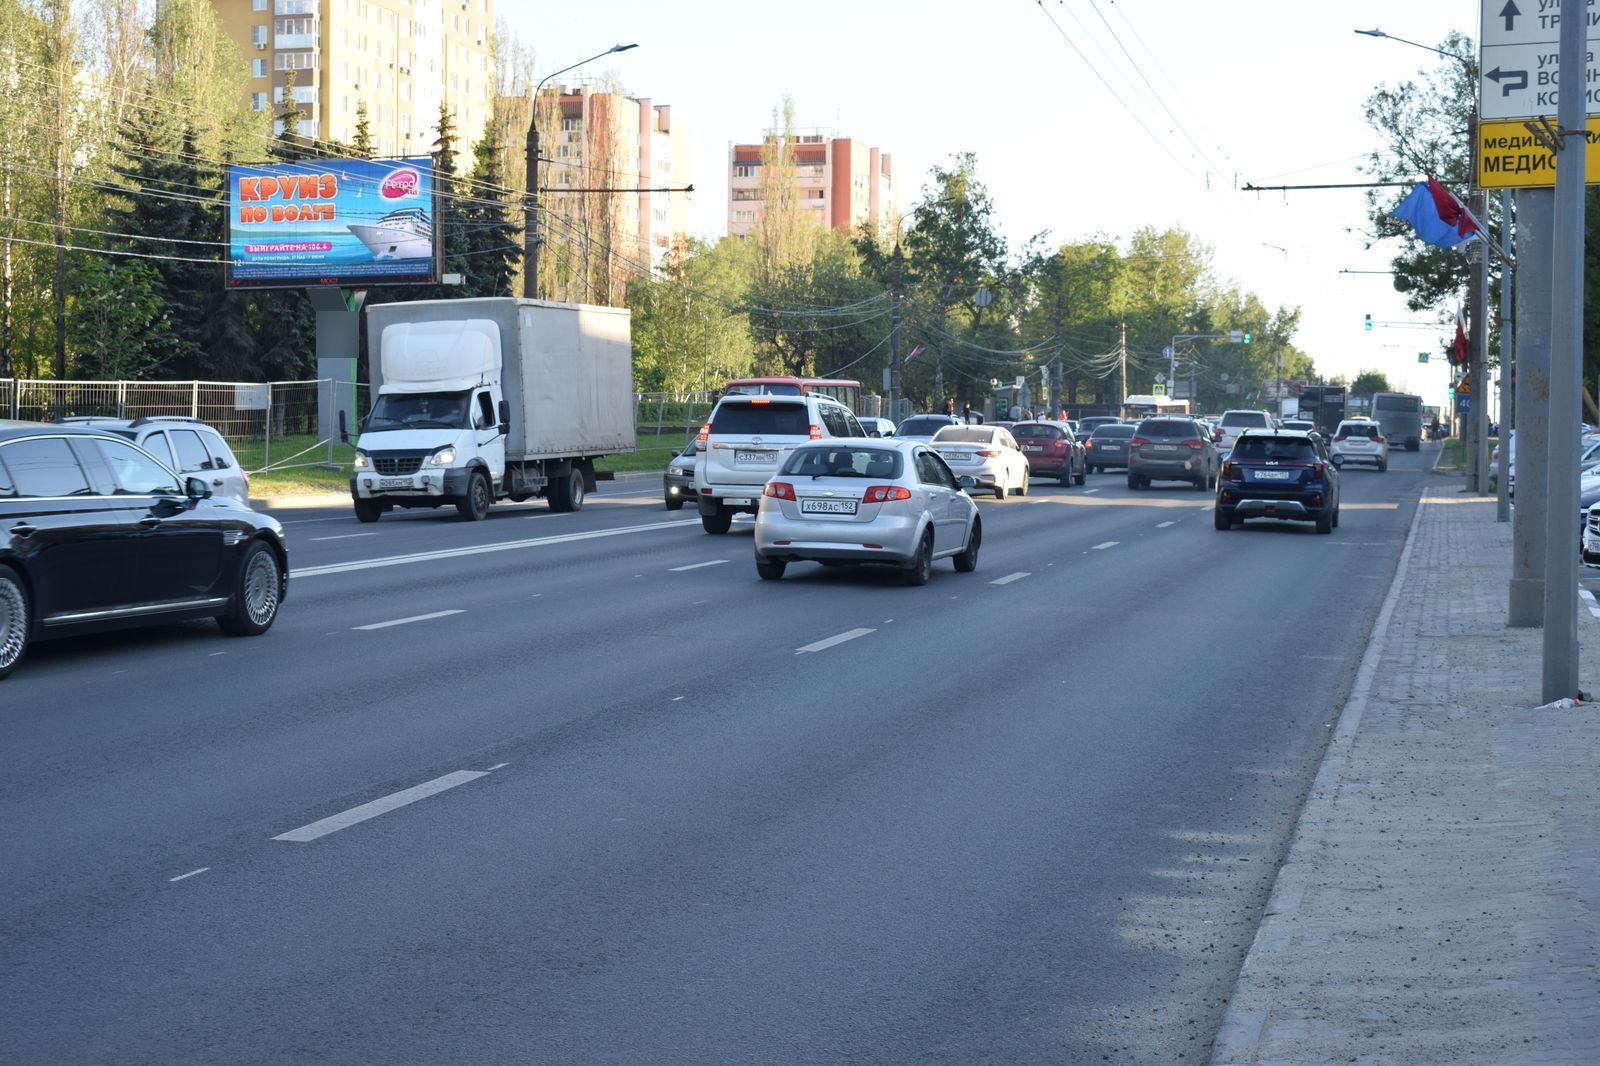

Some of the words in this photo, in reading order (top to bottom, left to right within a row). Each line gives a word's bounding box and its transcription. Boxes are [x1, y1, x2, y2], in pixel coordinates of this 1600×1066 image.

[1538, 0, 1595, 13] ула
[1538, 12, 1600, 29] ТРИ
[1537, 51, 1594, 69] ула
[239, 173, 338, 202] КРУИЗ
[239, 205, 269, 224] ПО
[271, 203, 336, 223] ВОЛГЕ
[248, 243, 294, 253] ВЫИГРАЙТЕ
[295, 243, 306, 252] НА
[805, 501, 839, 513] Х698АС
[840, 501, 854, 511] 152
